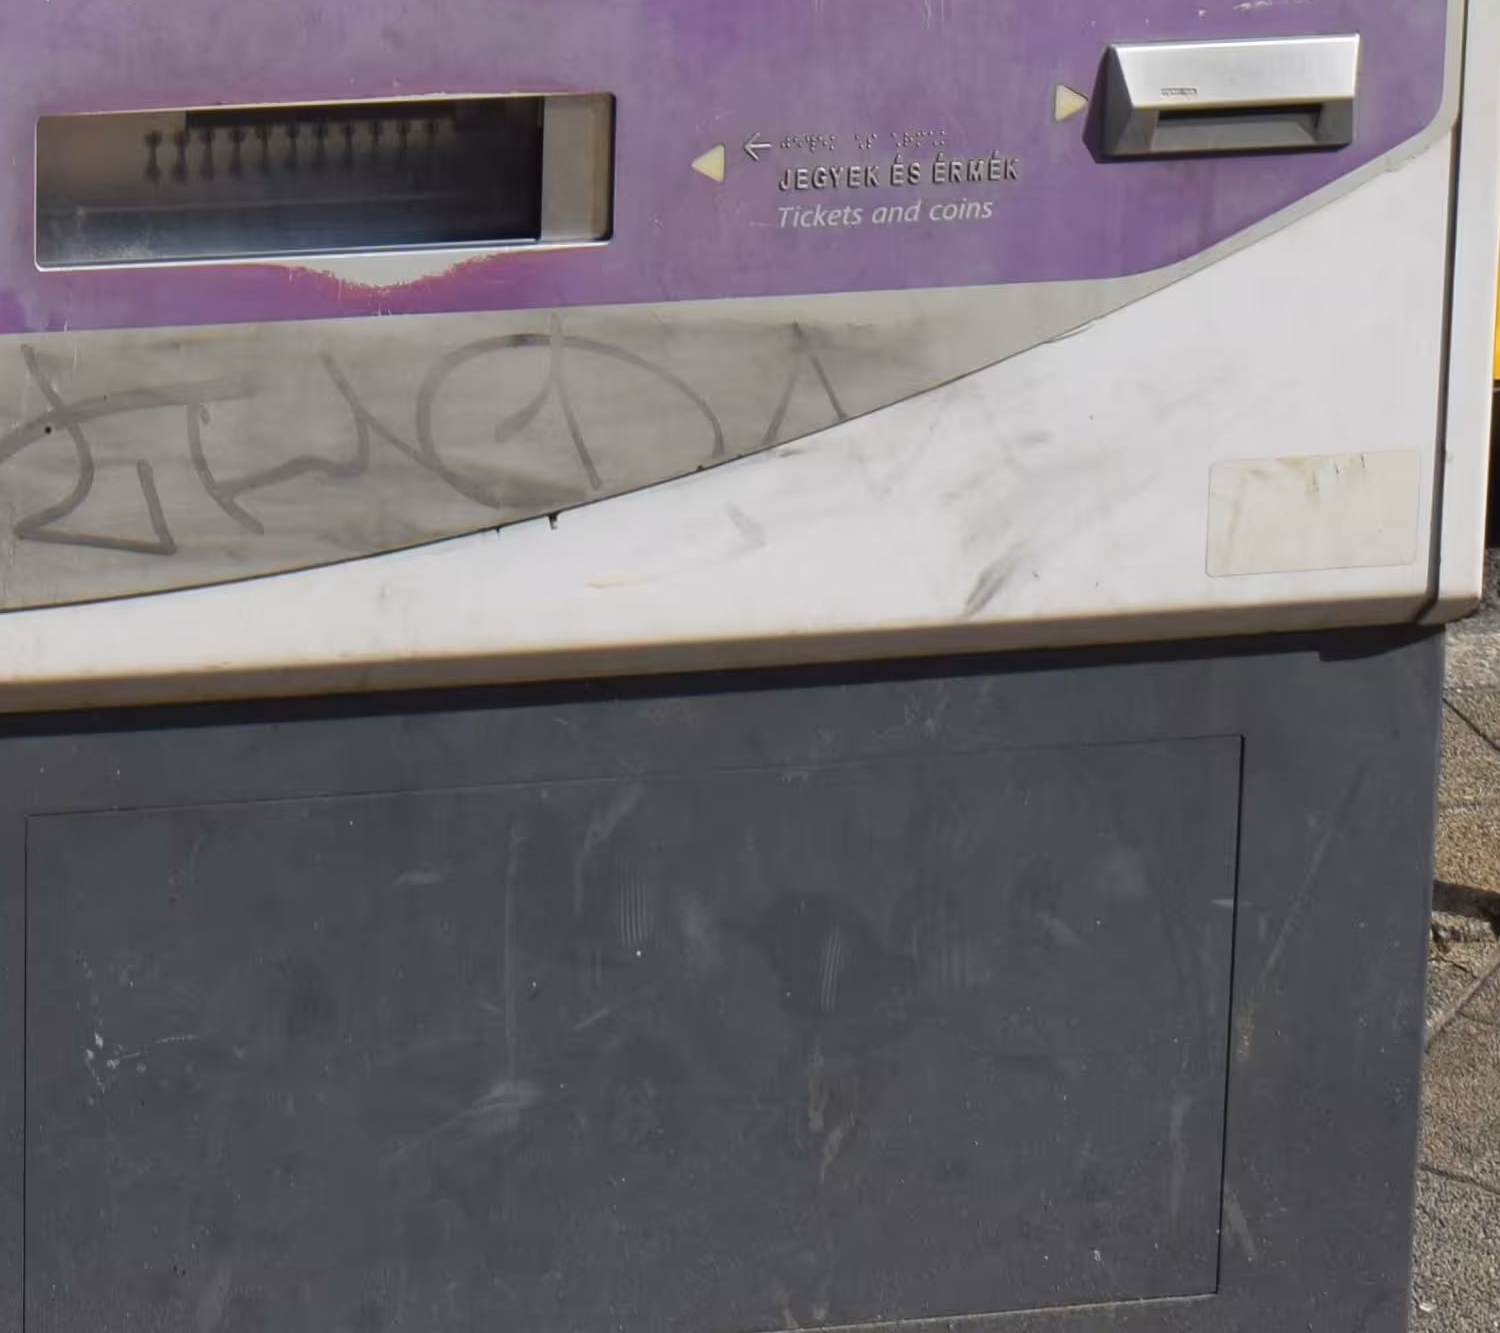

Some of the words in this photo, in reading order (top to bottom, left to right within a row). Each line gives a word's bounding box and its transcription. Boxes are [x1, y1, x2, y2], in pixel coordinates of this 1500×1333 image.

[778, 165, 878, 192] JEGYEK
[889, 155, 920, 187] ÉS
[931, 151, 1016, 184] ÉRMÉK
[778, 204, 863, 227] Tickets
[871, 199, 922, 223] and
[928, 197, 993, 221] coins
